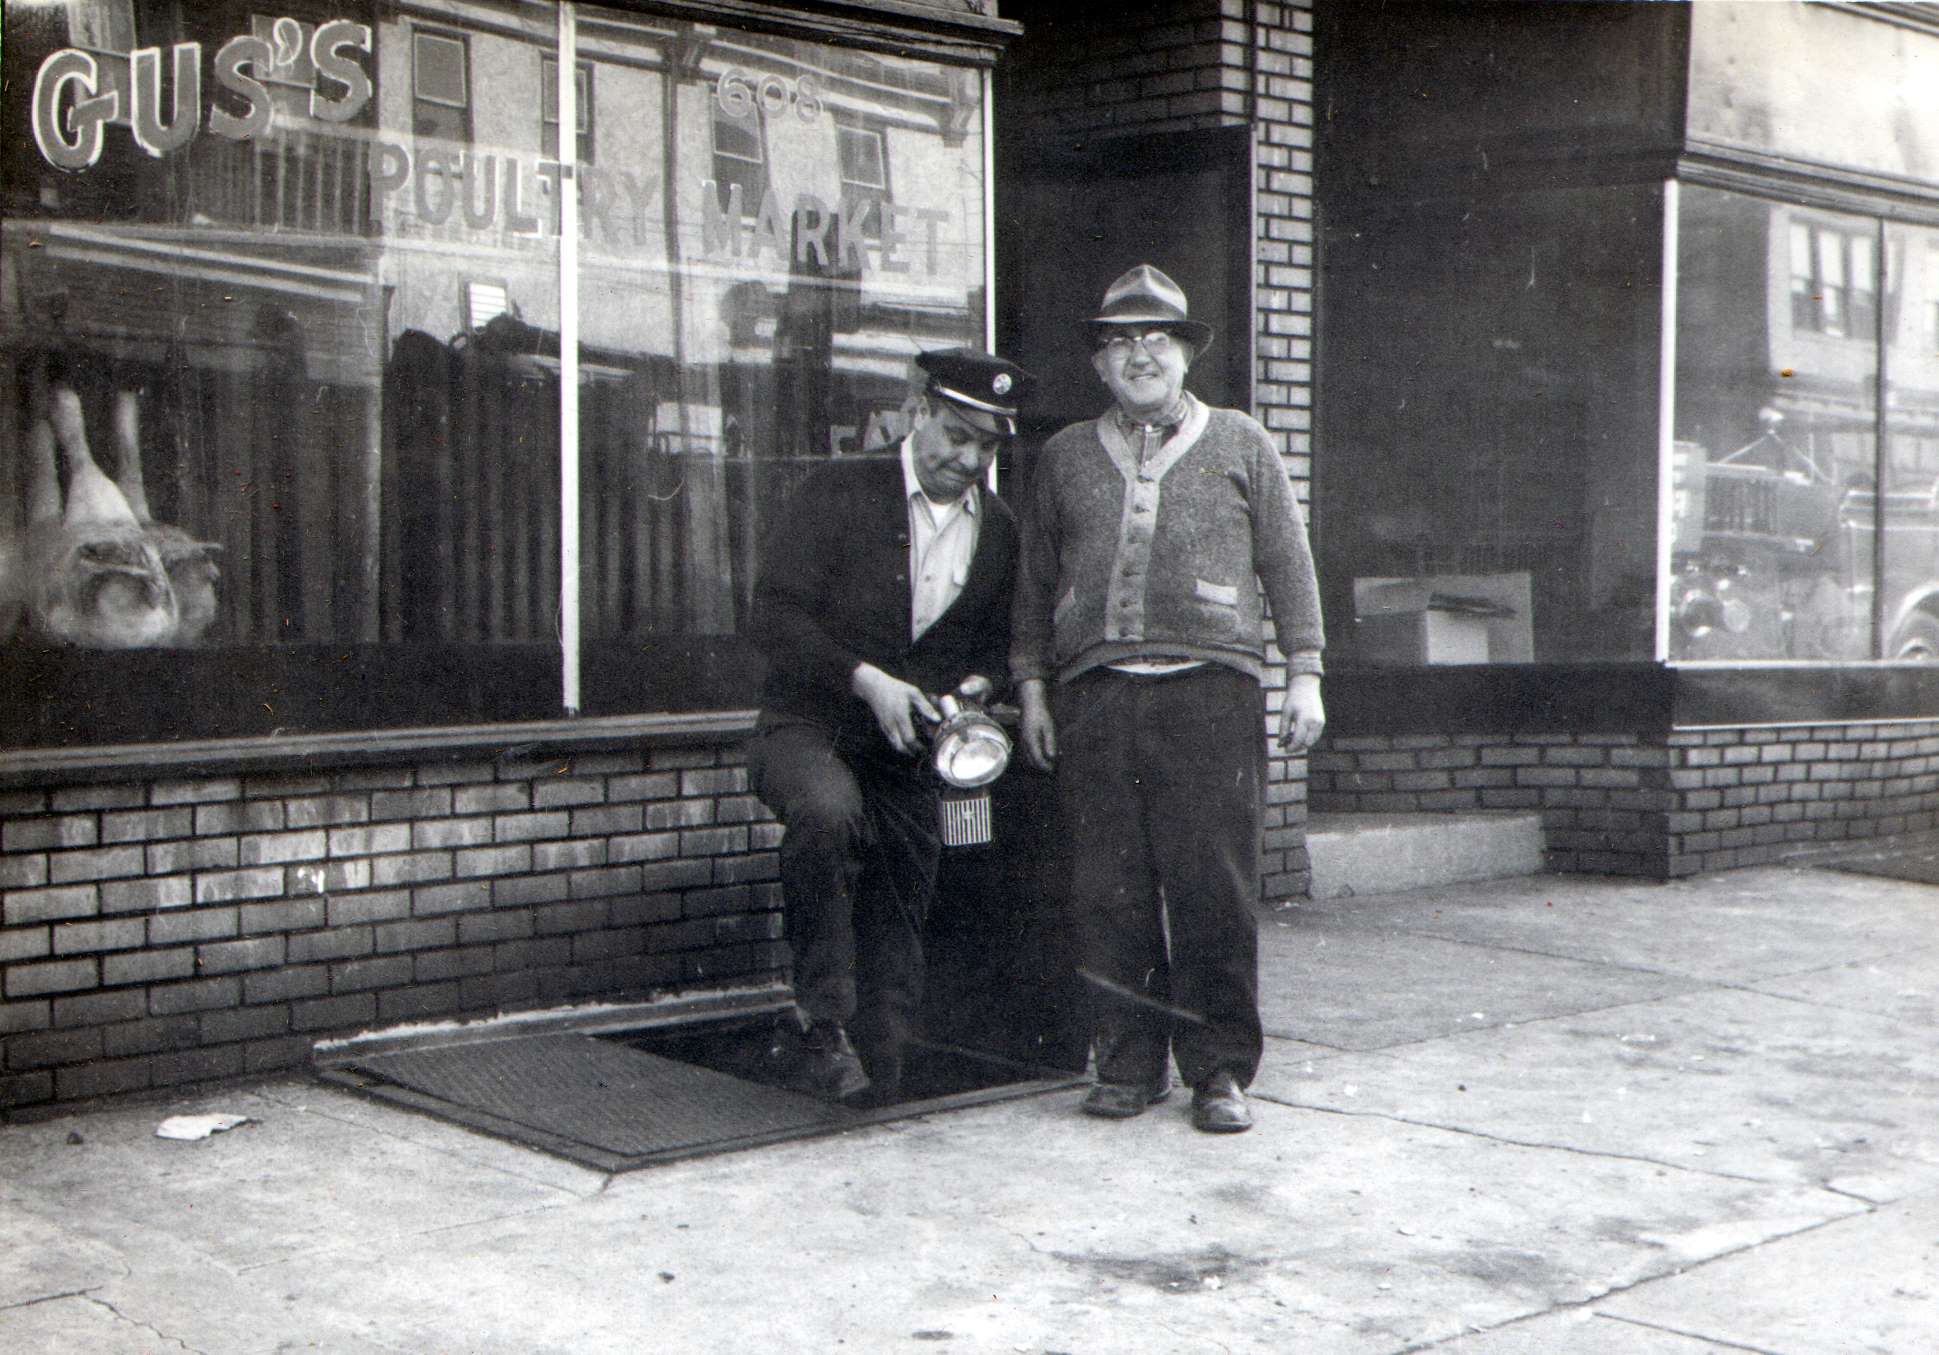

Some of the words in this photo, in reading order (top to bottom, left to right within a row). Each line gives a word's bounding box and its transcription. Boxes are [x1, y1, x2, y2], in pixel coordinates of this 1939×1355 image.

[31, 17, 373, 173] GUS'S
[366, 139, 658, 246] POULTRY
[700, 179, 950, 276] MARKET
